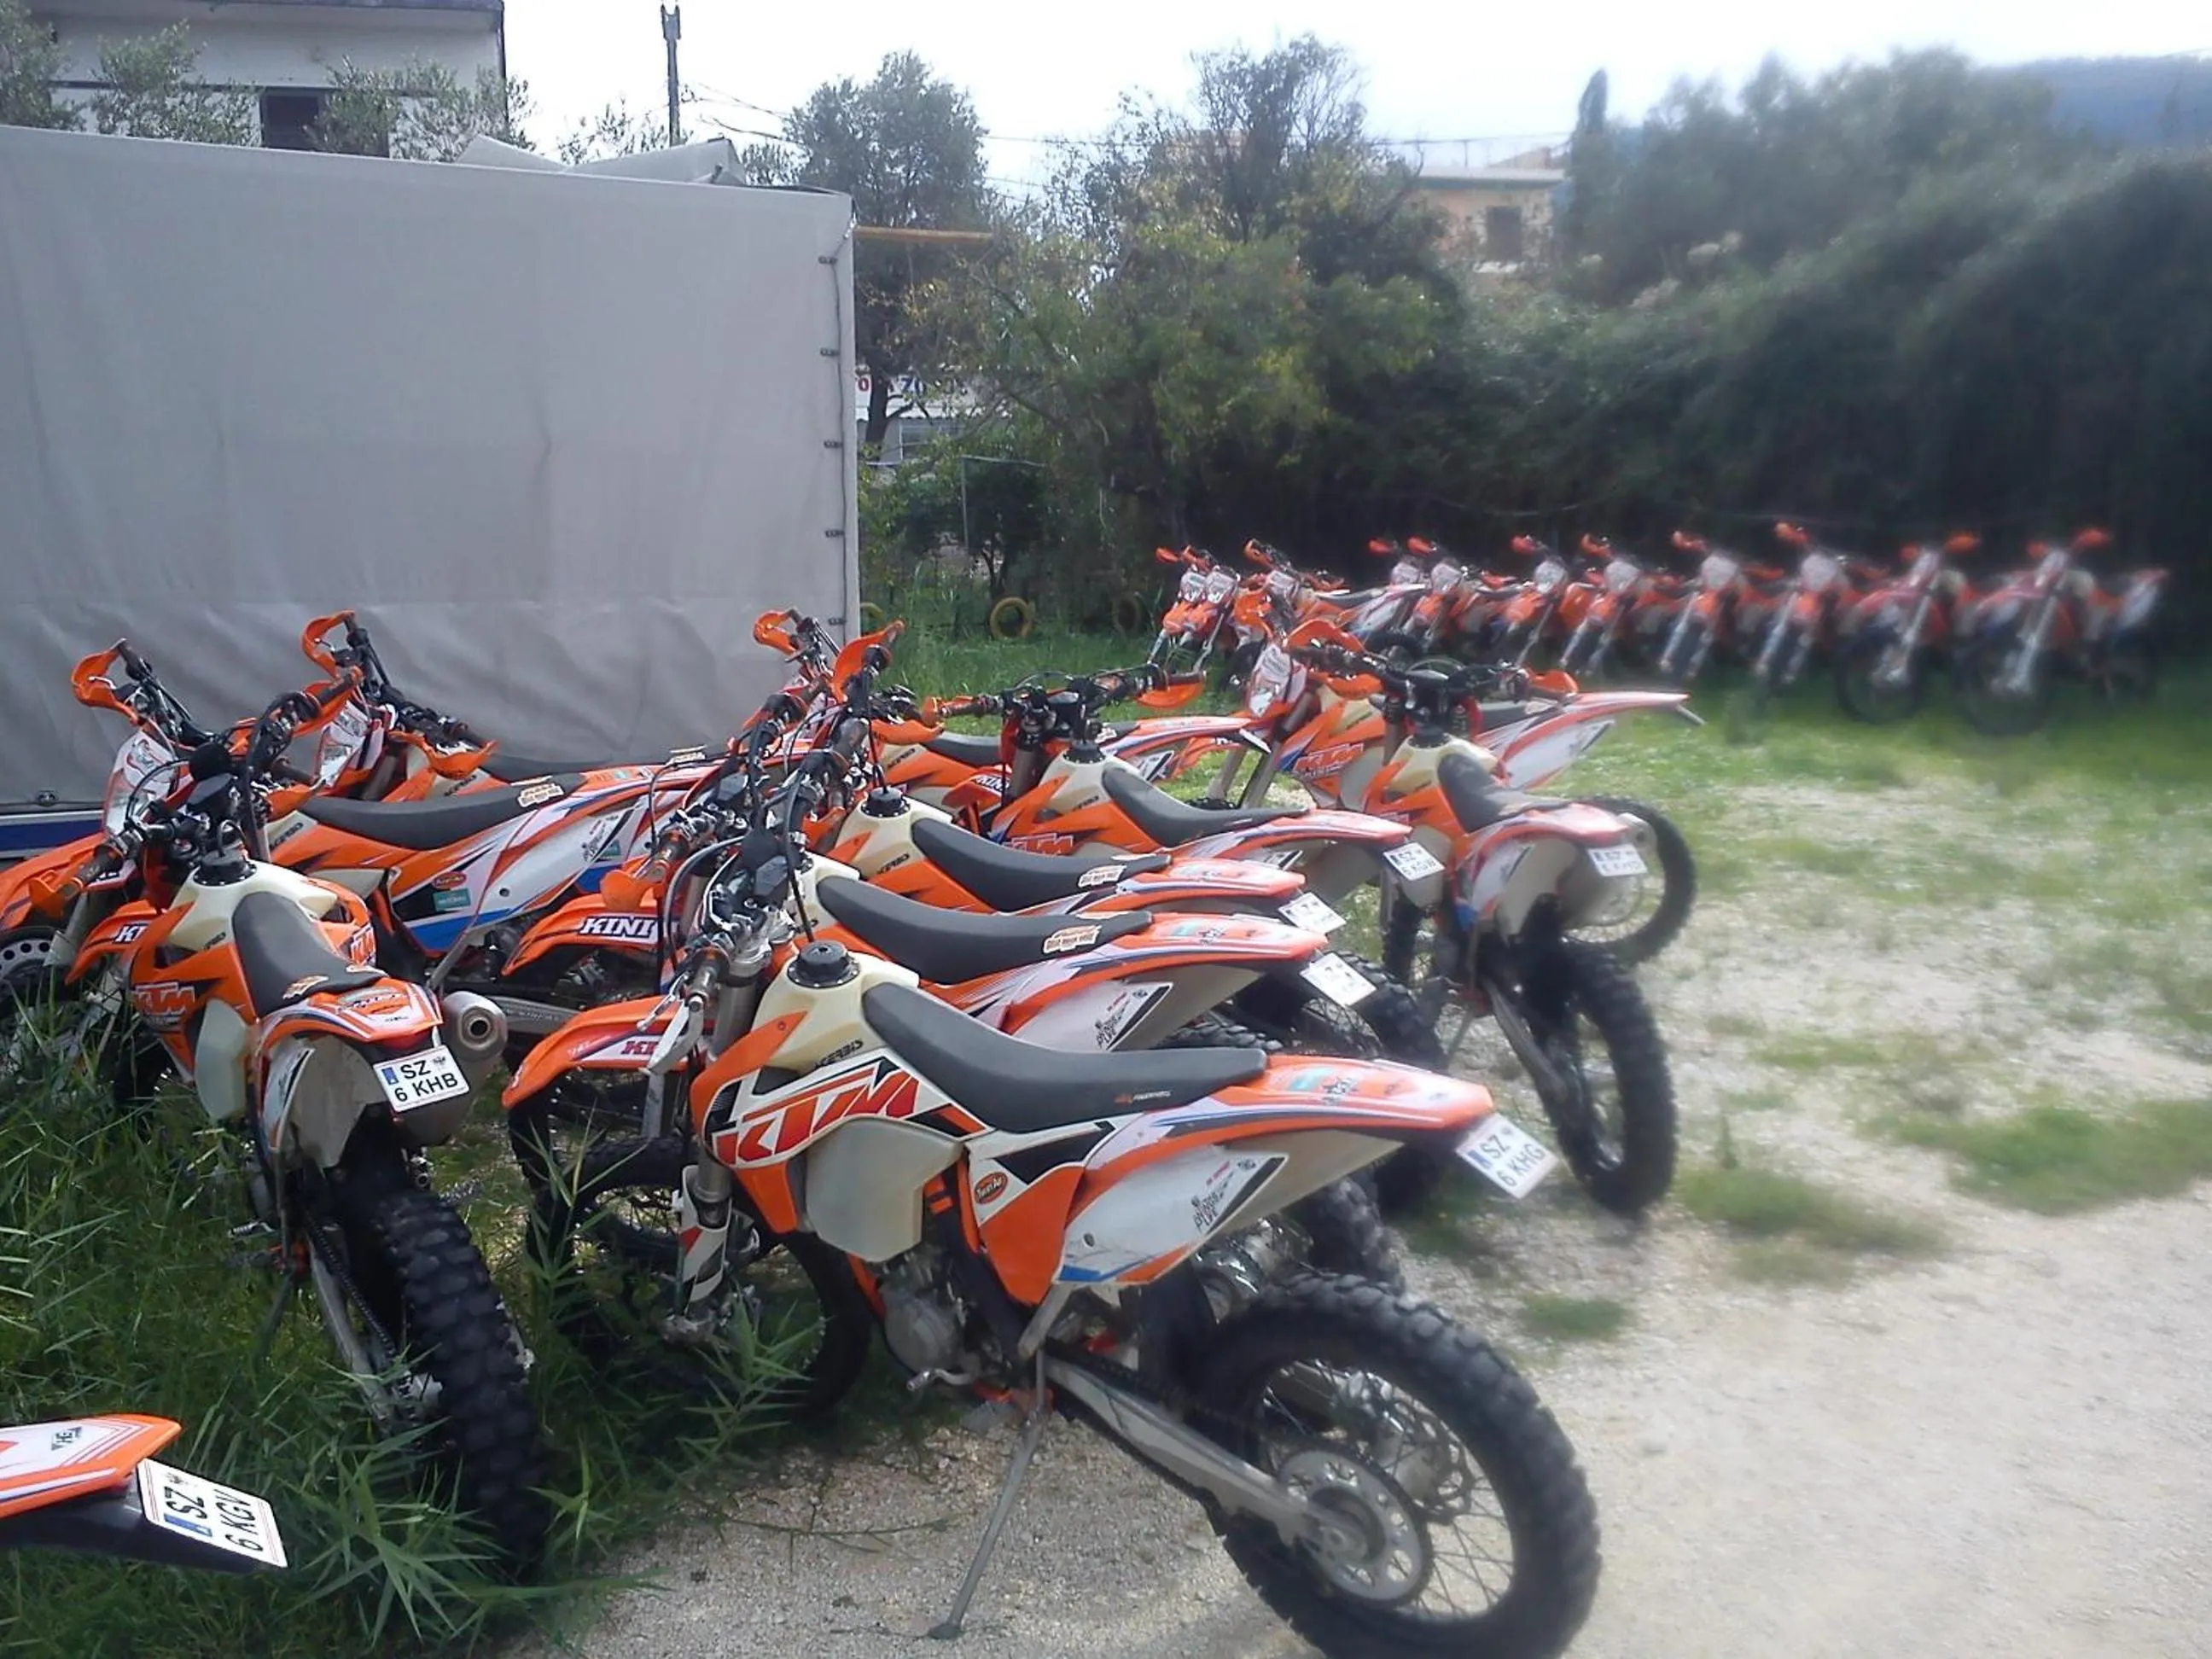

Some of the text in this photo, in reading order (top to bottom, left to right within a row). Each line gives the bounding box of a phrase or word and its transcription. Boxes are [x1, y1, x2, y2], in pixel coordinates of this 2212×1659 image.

[579, 917, 655, 938] KINI
[400, 1060, 432, 1080] SZ
[394, 1073, 458, 1103] 6 KHB
[715, 1067, 920, 1165] KTM
[1481, 1134, 1511, 1160] SZ
[1495, 1170, 1518, 1187] 6
[164, 1486, 207, 1520] SZ
[213, 1488, 264, 1552] 6 KGV
